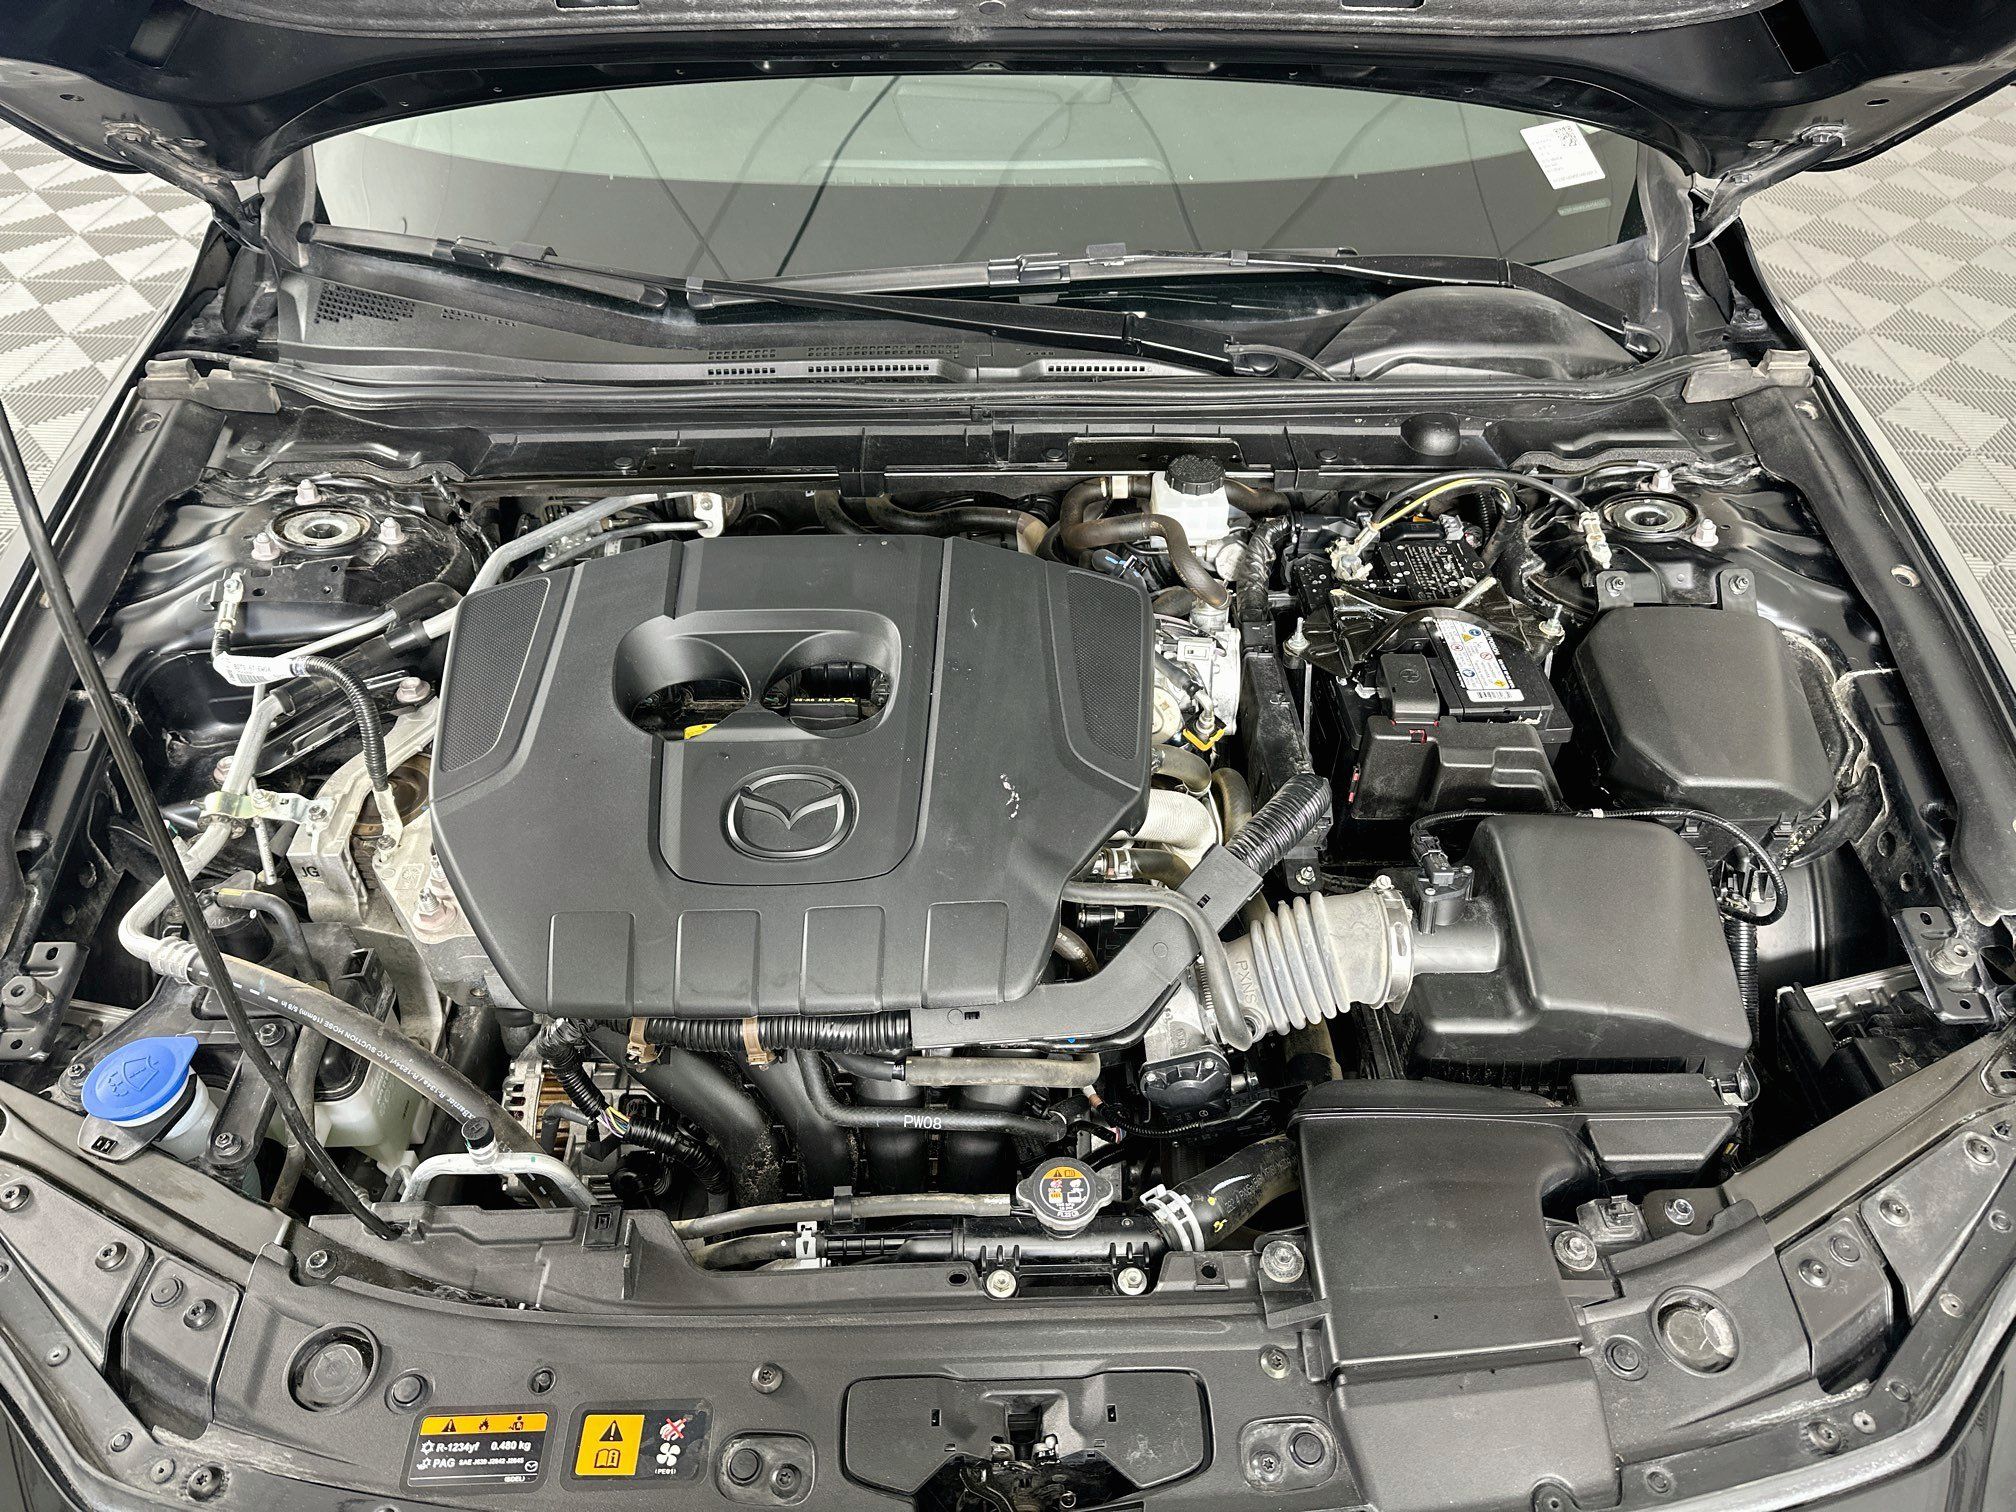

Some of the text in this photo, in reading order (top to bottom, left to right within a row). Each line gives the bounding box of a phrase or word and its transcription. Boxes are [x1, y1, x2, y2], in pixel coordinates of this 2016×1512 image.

[301, 866, 320, 878] JG
[1235, 960, 1259, 1004] PXNS
[323, 1020, 345, 1036] HOSE
[344, 1031, 378, 1054] SUCTION
[376, 1050, 391, 1061] A/C
[903, 1114, 943, 1130] PW08
[435, 1440, 532, 1454] R-1234yf 0.480 kg
[432, 1457, 456, 1469] PAG
[458, 1458, 472, 1466] SAE
